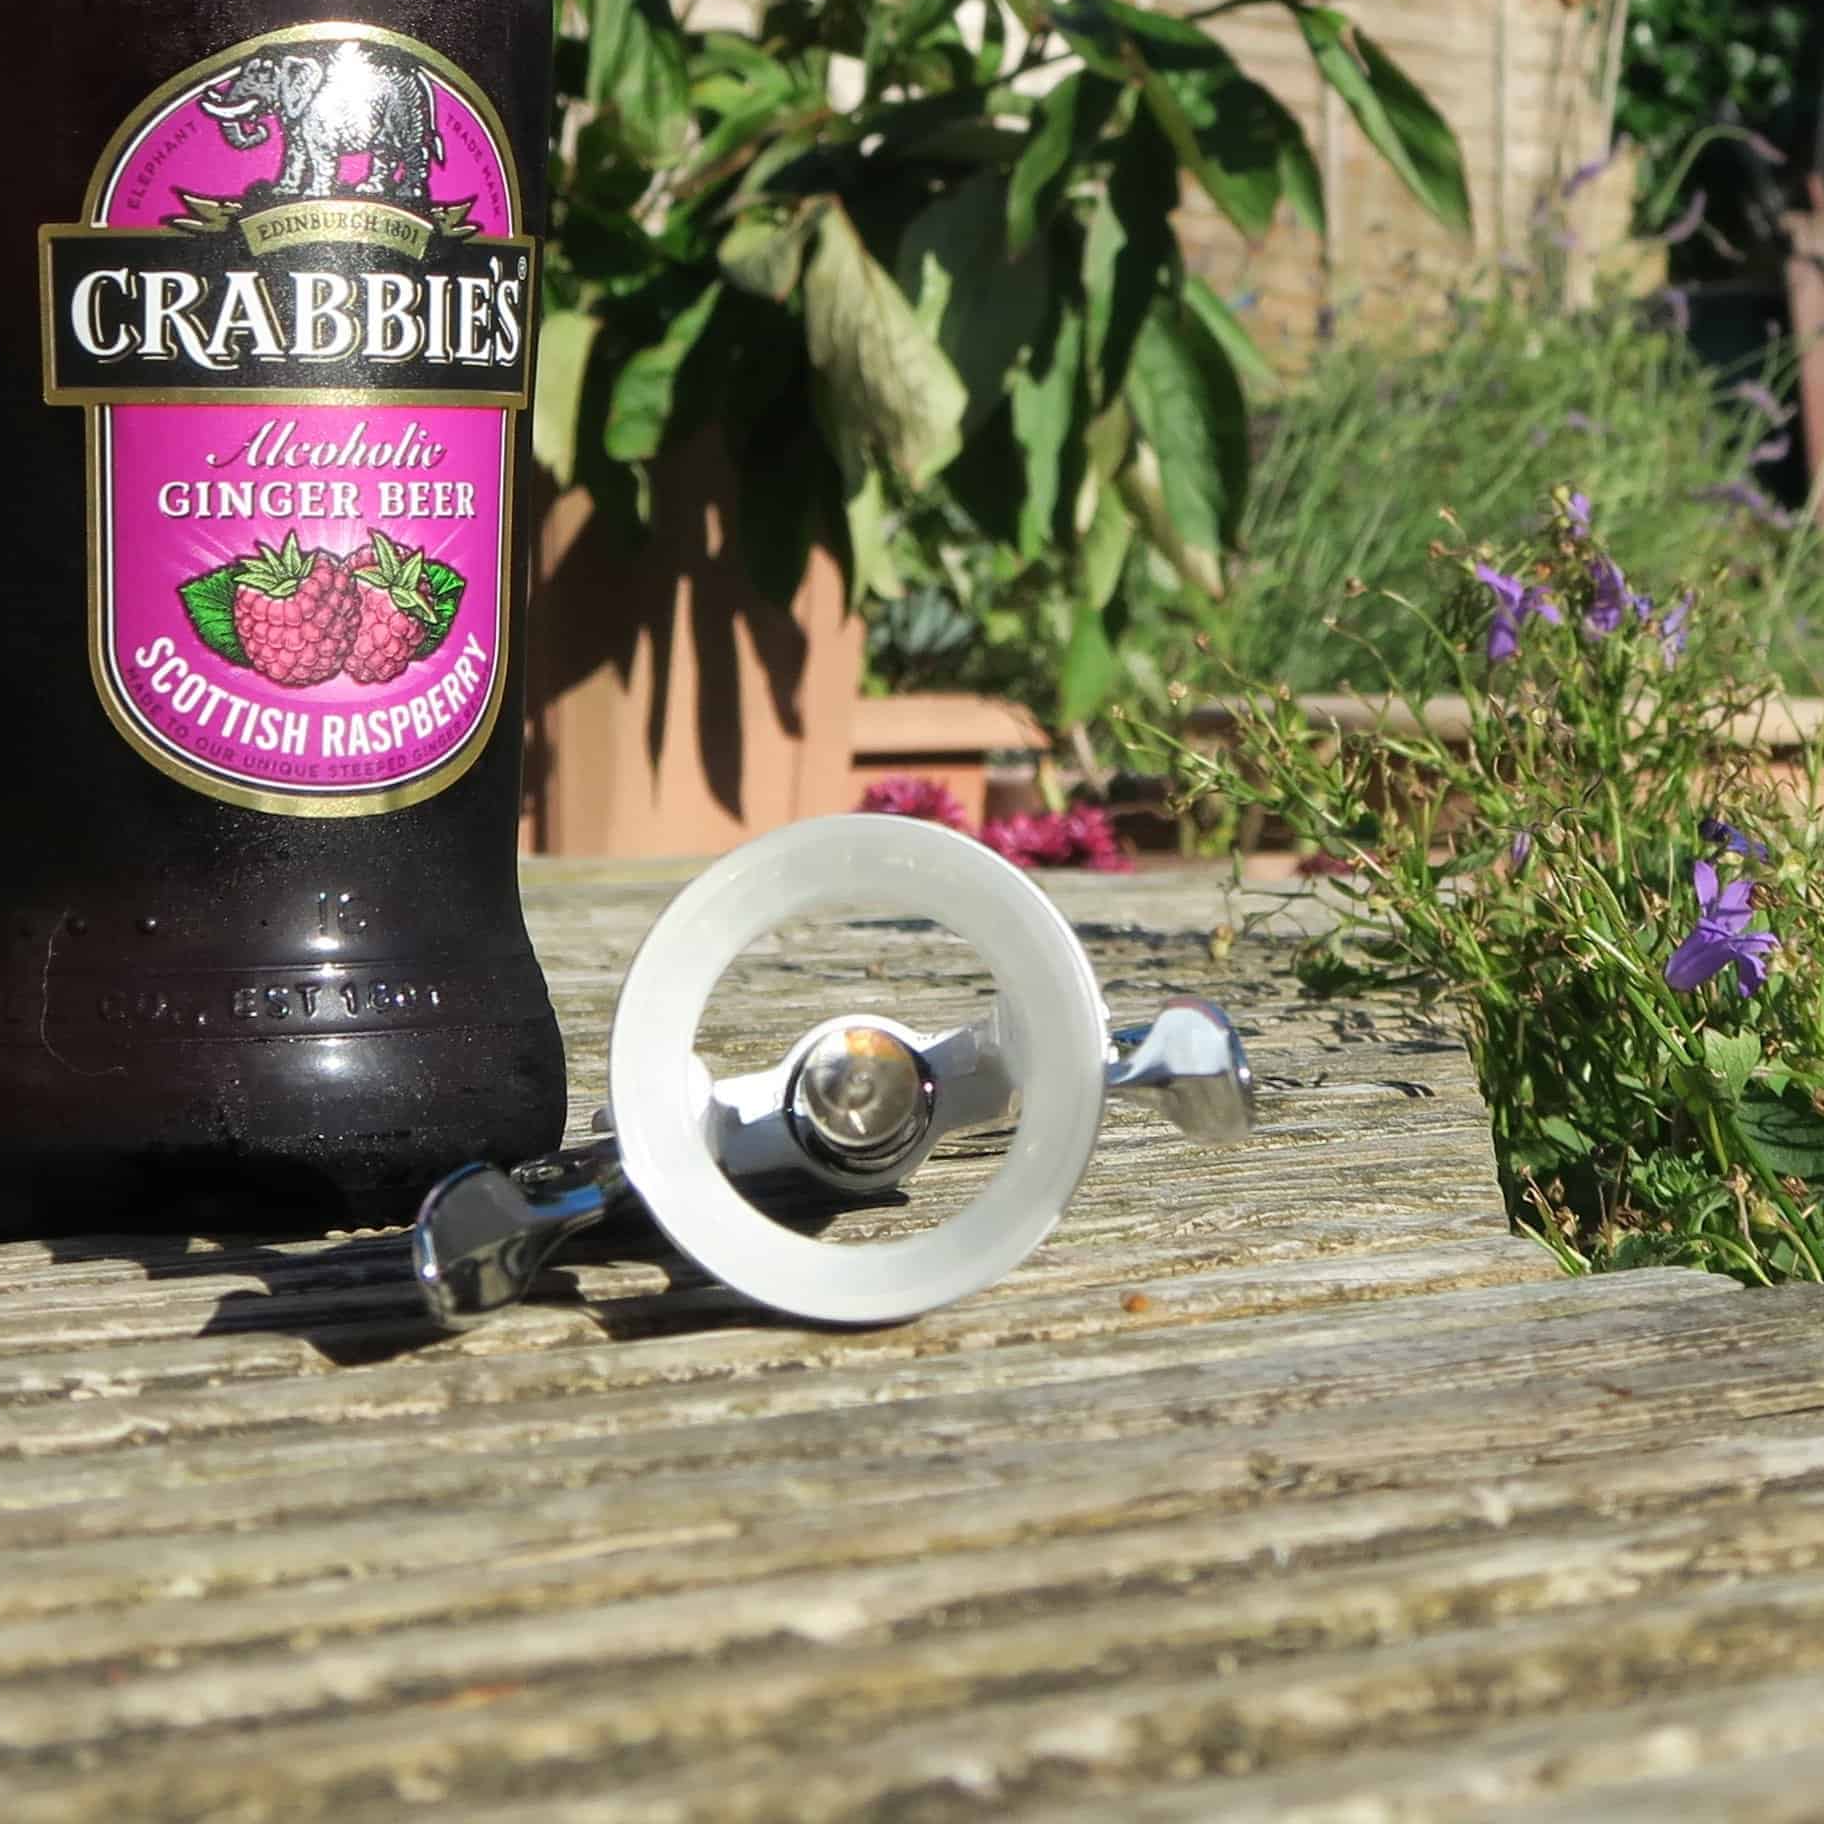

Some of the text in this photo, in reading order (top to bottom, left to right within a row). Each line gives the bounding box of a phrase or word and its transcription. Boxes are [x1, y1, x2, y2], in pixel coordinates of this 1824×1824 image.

[127, 120, 199, 211] ELEPHANT
[445, 113, 503, 217] TRADE MARK
[257, 213, 420, 245] EDINBURGH 1801
[71, 256, 521, 370] CRABBIE'S
[206, 419, 446, 469] Alcoholic
[157, 481, 477, 520] GINGER BEER
[135, 636, 309, 757] SCOTTISH
[321, 631, 488, 758] RASPBERRY
[167, 716, 190, 739] TO
[194, 736, 237, 762] OUR
[242, 754, 322, 778] UNIQUE
[328, 754, 408, 778] STEEPED
[412, 720, 462, 762] GINGER
[232, 982, 321, 1020] EST
